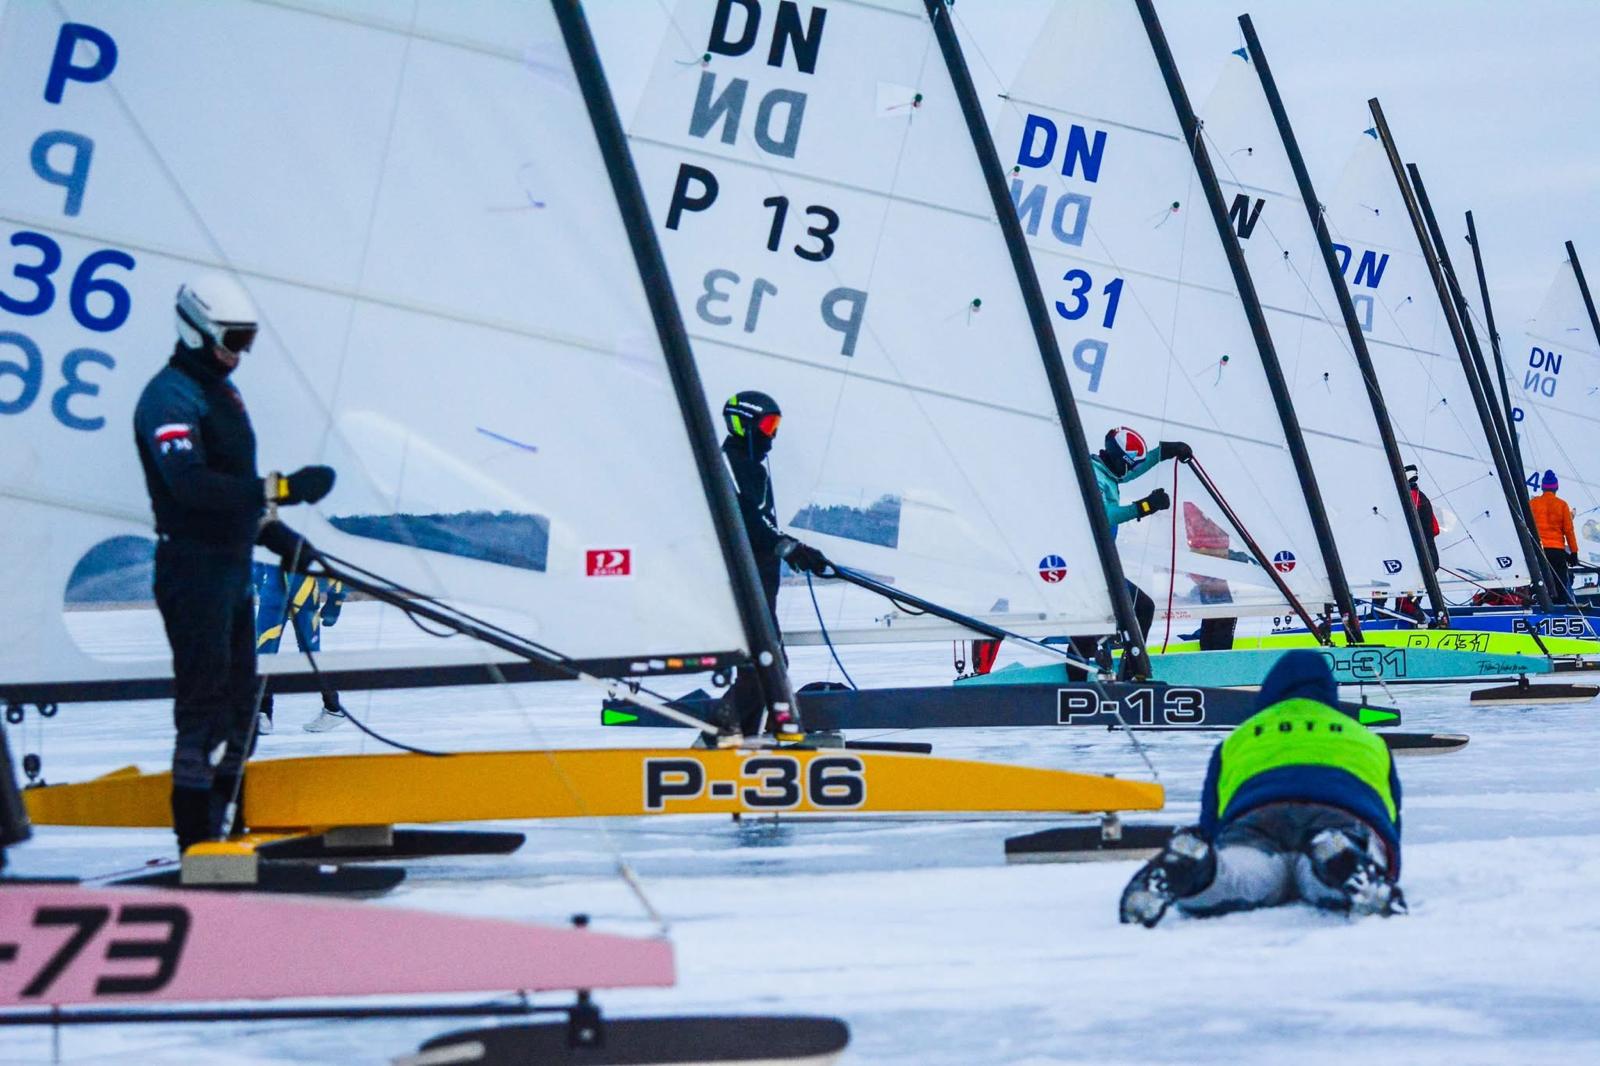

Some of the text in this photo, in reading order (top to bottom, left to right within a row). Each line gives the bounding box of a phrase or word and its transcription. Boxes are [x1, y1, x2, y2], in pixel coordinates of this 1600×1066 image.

[44, 22, 118, 104] P
[706, 0, 828, 74] DN
[1017, 114, 1107, 183] DN
[665, 163, 840, 262] P 13
[0, 231, 136, 332] 36
[1055, 269, 1124, 329] 31
[1528, 346, 1562, 375] DN
[1057, 688, 1206, 725] P-13
[643, 755, 867, 812] P-36
